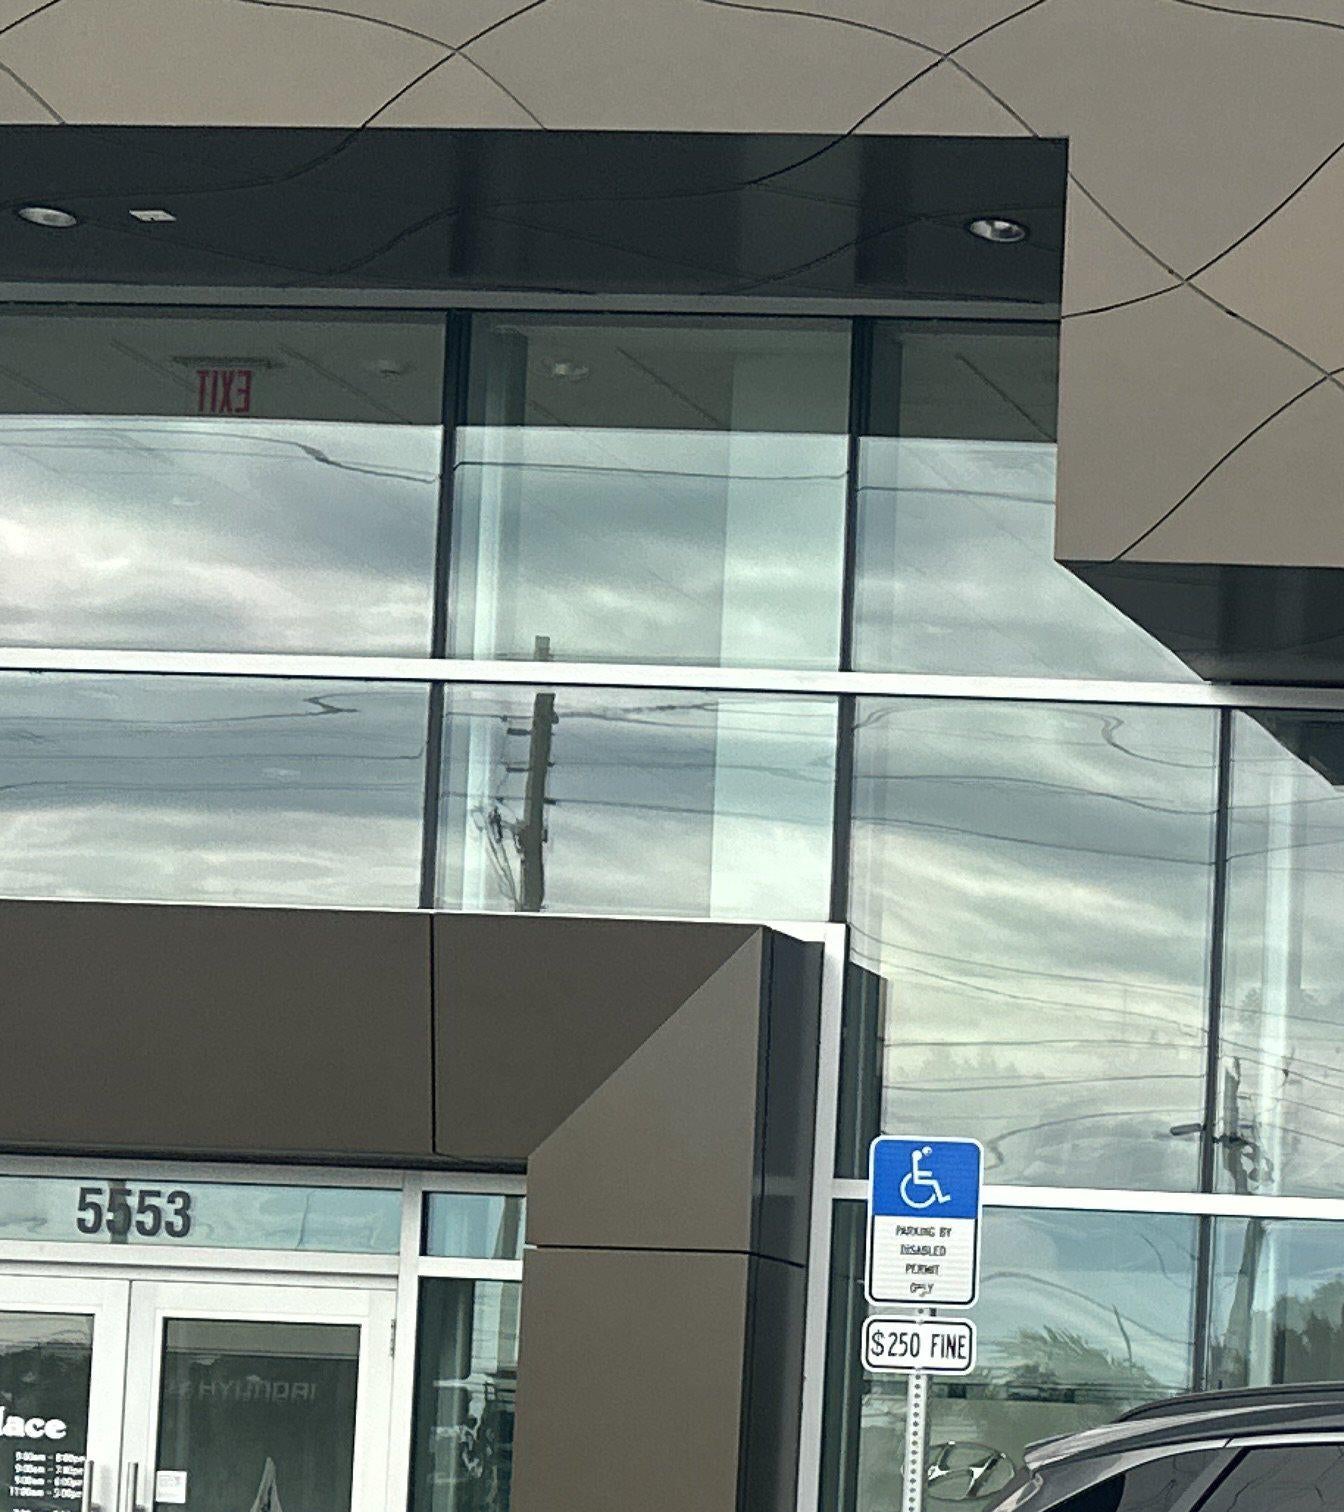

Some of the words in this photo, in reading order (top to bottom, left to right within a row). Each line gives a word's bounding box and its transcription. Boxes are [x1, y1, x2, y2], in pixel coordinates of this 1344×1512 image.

[77, 1187, 192, 1238] 5553
[895, 1224, 936, 1238] PARKING
[939, 1227, 952, 1238] BY
[899, 1243, 947, 1257] DISABLED
[905, 1263, 940, 1276] PERMIT
[871, 1329, 921, 1359] $250
[930, 1333, 967, 1360] FINE
